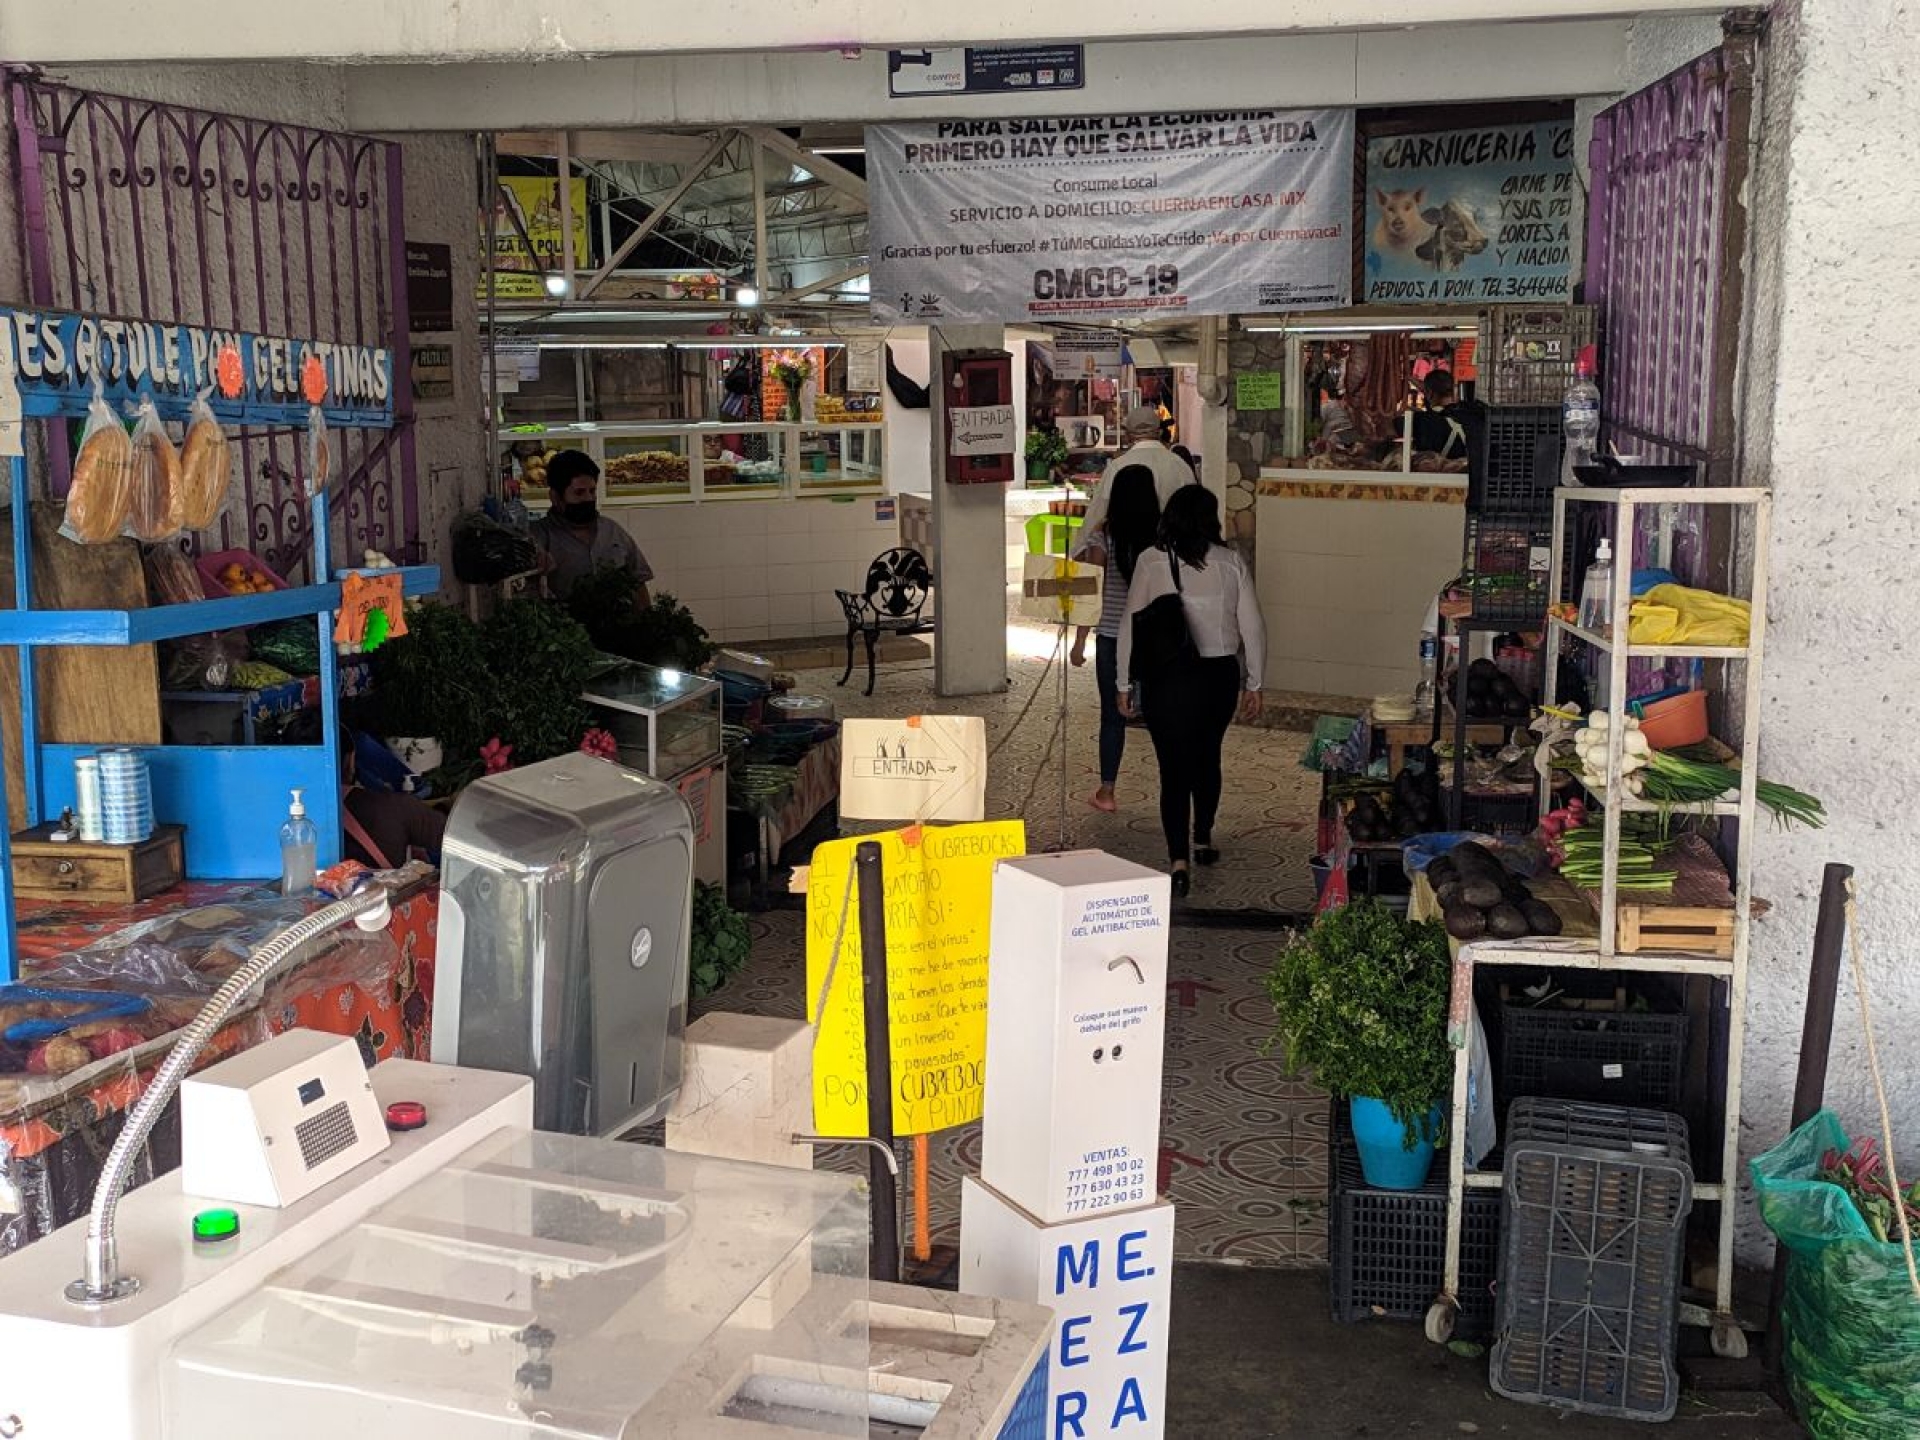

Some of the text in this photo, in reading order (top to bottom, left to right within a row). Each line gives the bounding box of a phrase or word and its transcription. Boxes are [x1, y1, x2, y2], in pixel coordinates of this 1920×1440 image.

[938, 120, 1002, 138] PARA
[1007, 117, 1103, 135] SALVAR
[1110, 115, 1142, 129] LA
[904, 120, 1318, 164] PRIMERO HAY QUE SALVAR LA VIDA
[1383, 130, 1537, 169] CARNICERIA
[1053, 172, 1158, 193] Consume Local
[1500, 173, 1547, 196] CARNE
[950, 205, 1023, 223] SERVICIO
[1028, 204, 1039, 219] A
[1044, 201, 1137, 219] DOMICILIO:
[1499, 200, 1512, 220] Y
[1512, 199, 1542, 221] SUS
[881, 244, 932, 261] ¡Gracias
[935, 244, 956, 260] por
[960, 243, 974, 255] tu
[977, 239, 1036, 255] esfuerzo!
[1232, 229, 1256, 246] por
[1259, 224, 1341, 241] Cuernavaca!
[1498, 223, 1555, 245] CORTES
[1495, 249, 1508, 268] Y
[1034, 263, 1178, 300] CMCC-19
[1370, 280, 1425, 299] PEDIDOS
[1428, 280, 1439, 298] A
[1443, 279, 1475, 298] DOM.
[951, 410, 1012, 429] ENTRADA
[872, 759, 936, 777] ENTRADA
[922, 832, 1017, 860] CUBREBOCAS
[811, 884, 831, 910] ES
[1086, 894, 1149, 911] DISPENSADOR
[1140, 906, 1153, 916] DE
[813, 911, 839, 940] NO
[1071, 918, 1160, 937] GEL ANTIBACTERIAL
[1073, 1012, 1105, 1024] Coloque
[901, 1103, 915, 1132] Y
[1068, 1158, 1145, 1181] 777 498 10 02
[1066, 1173, 1145, 1197] 777 630 43 23
[1066, 1188, 1144, 1214] 777 222 90 63
